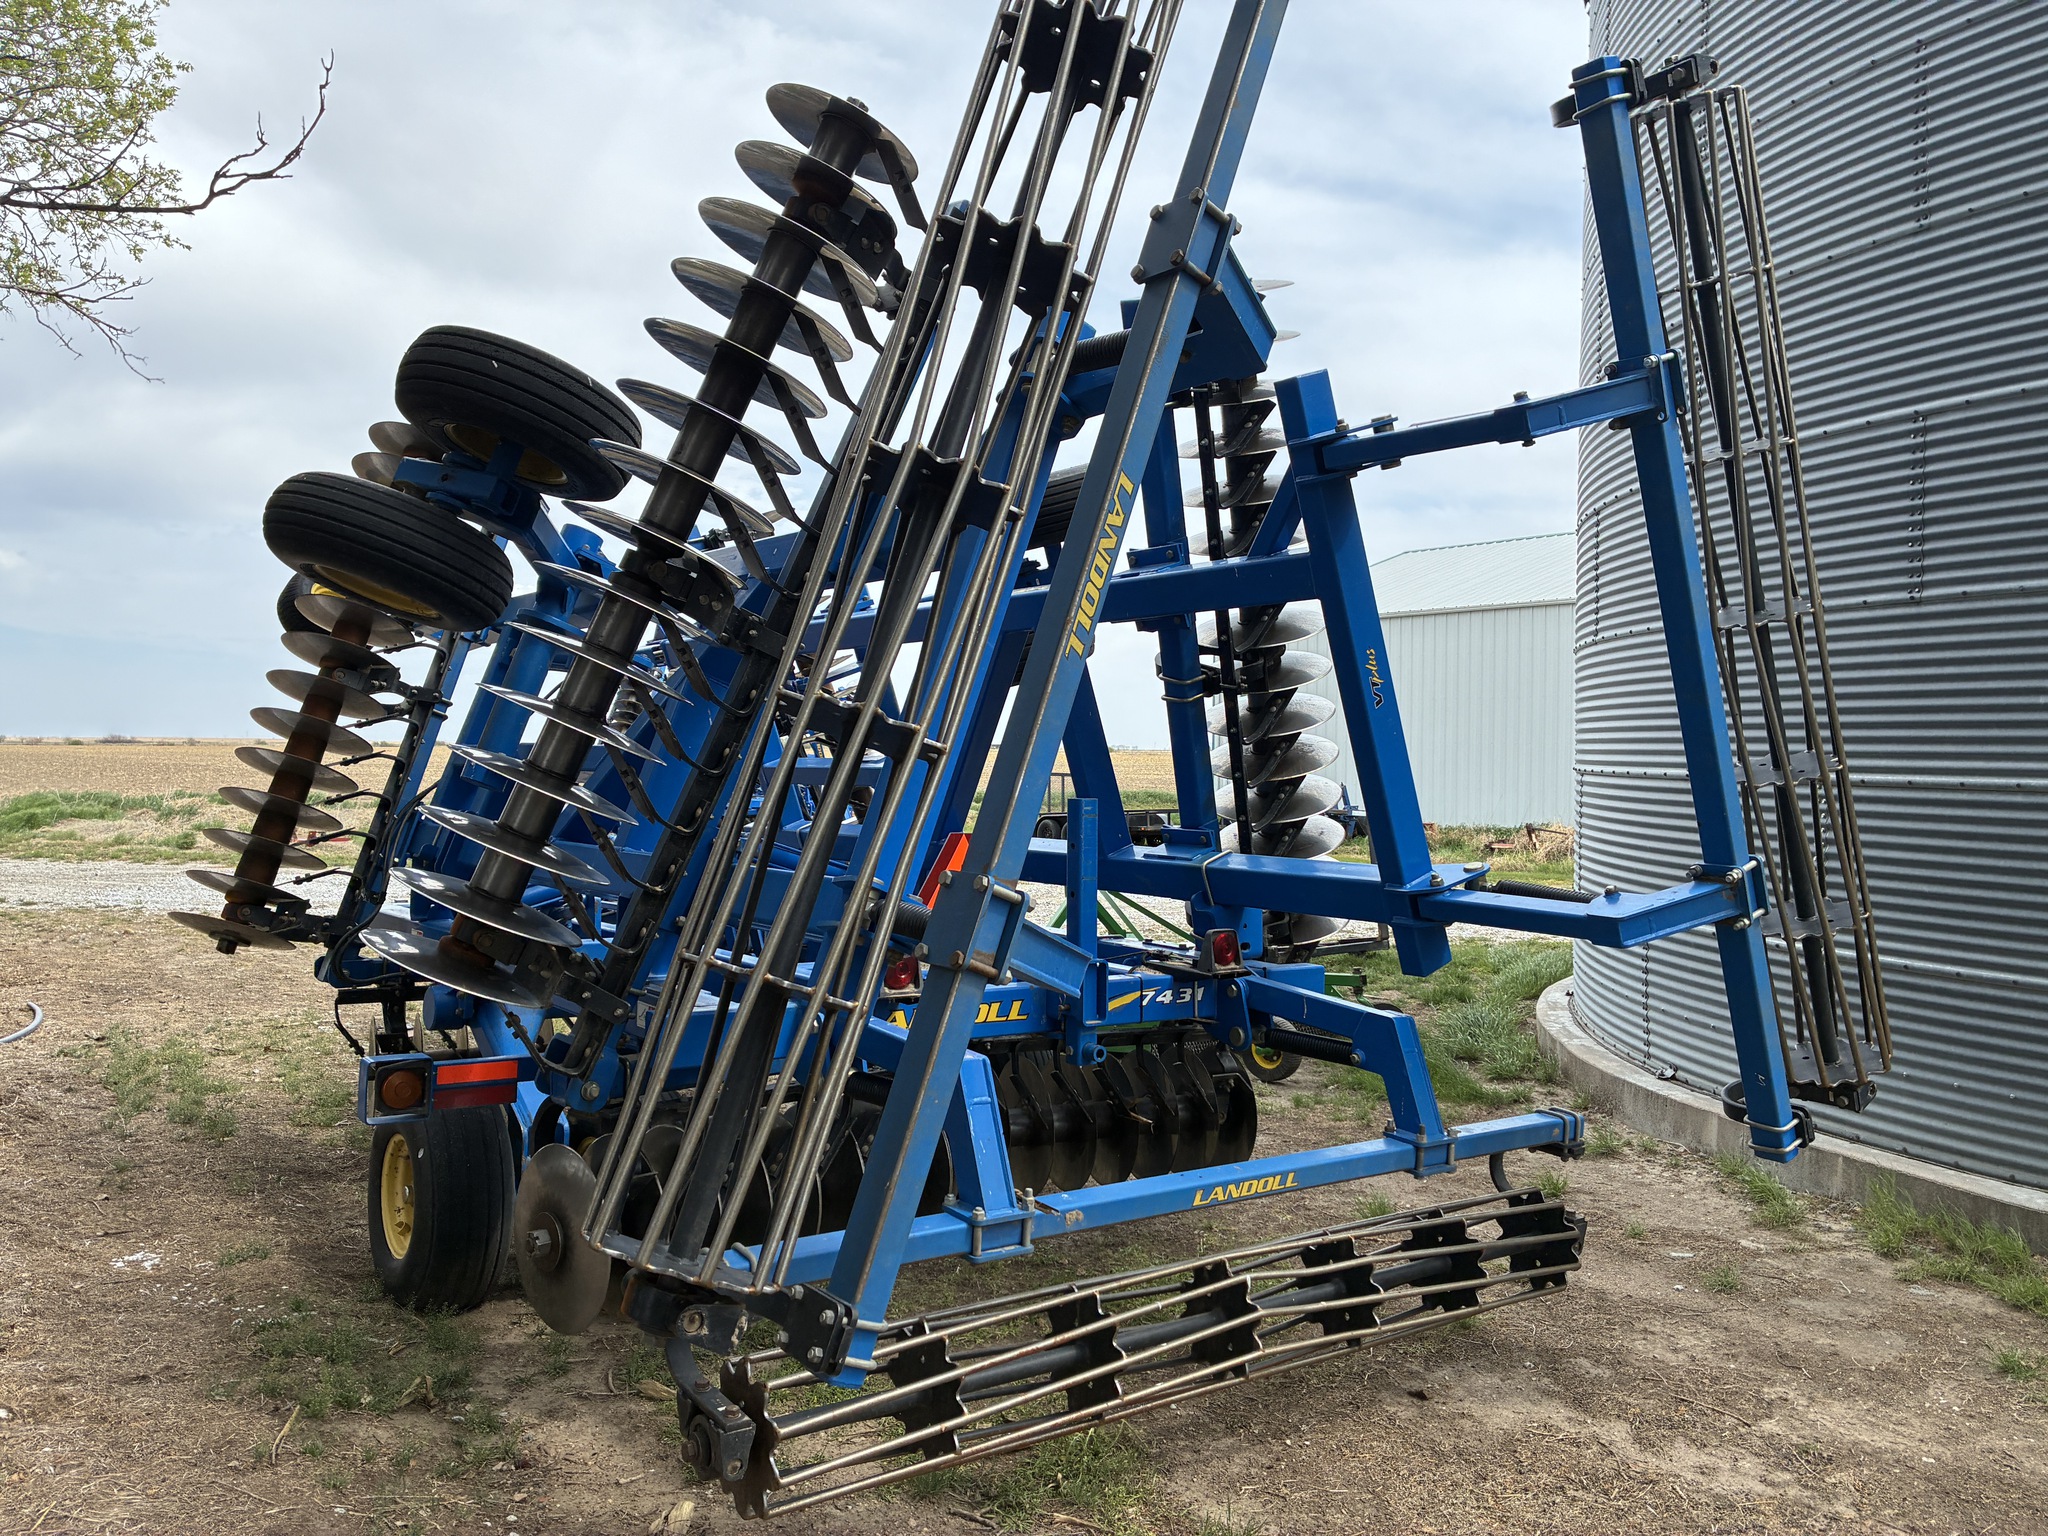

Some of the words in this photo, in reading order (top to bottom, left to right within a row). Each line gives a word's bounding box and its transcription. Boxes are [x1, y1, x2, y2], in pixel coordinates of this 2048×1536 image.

[1065, 469, 1135, 660] LANDOLL
[1142, 987, 1205, 1006] 7431
[1192, 1171, 1299, 1207] LANDOLL
